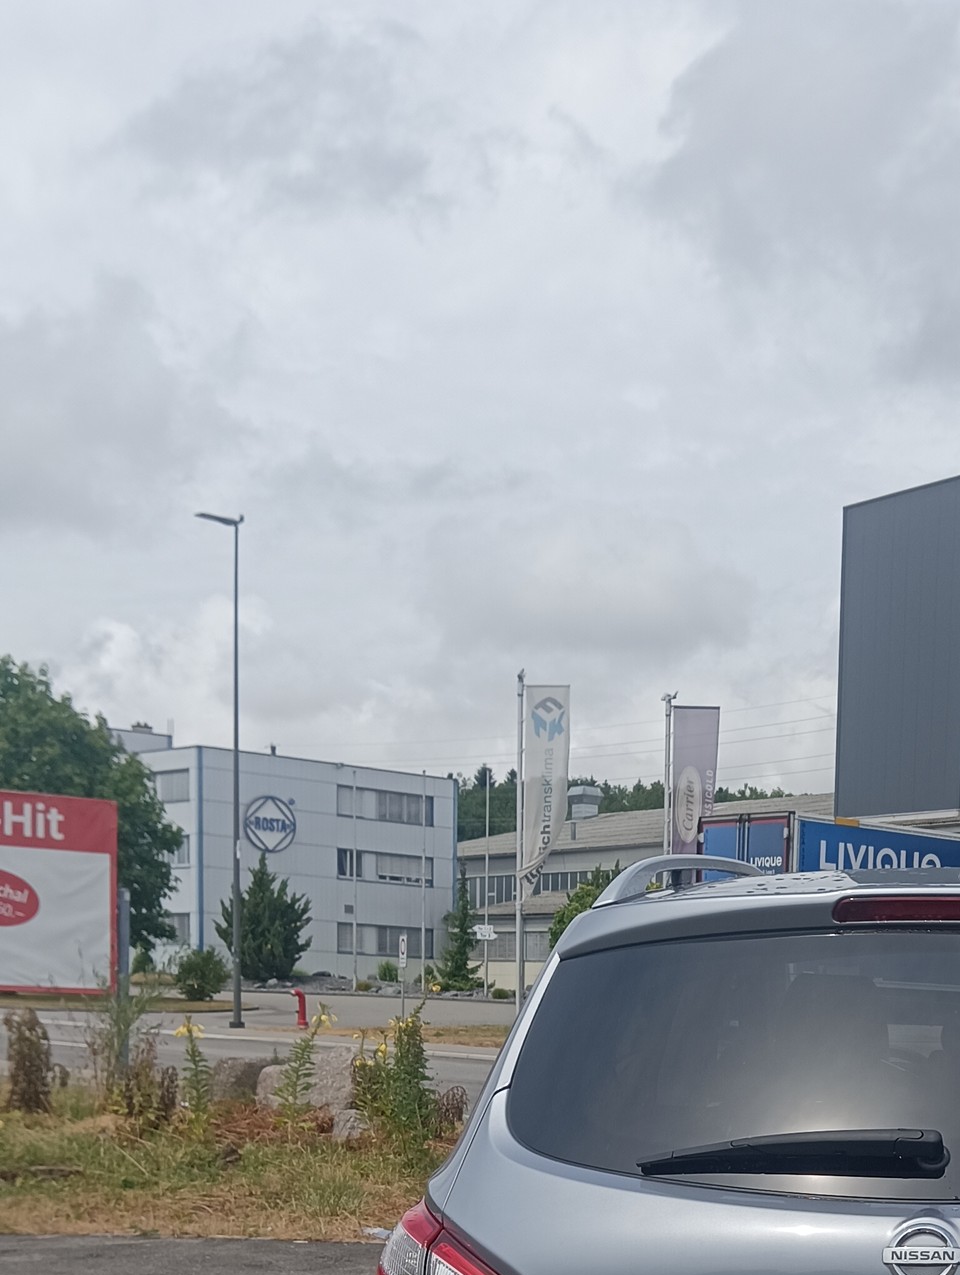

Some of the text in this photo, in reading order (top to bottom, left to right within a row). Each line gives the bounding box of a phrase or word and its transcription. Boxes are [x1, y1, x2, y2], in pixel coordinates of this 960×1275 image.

[682, 776, 695, 832] Carrier
[0, 801, 65, 841] Hit
[254, 816, 288, 833] ROSTA
[891, 1250, 955, 1261] NISSAN
